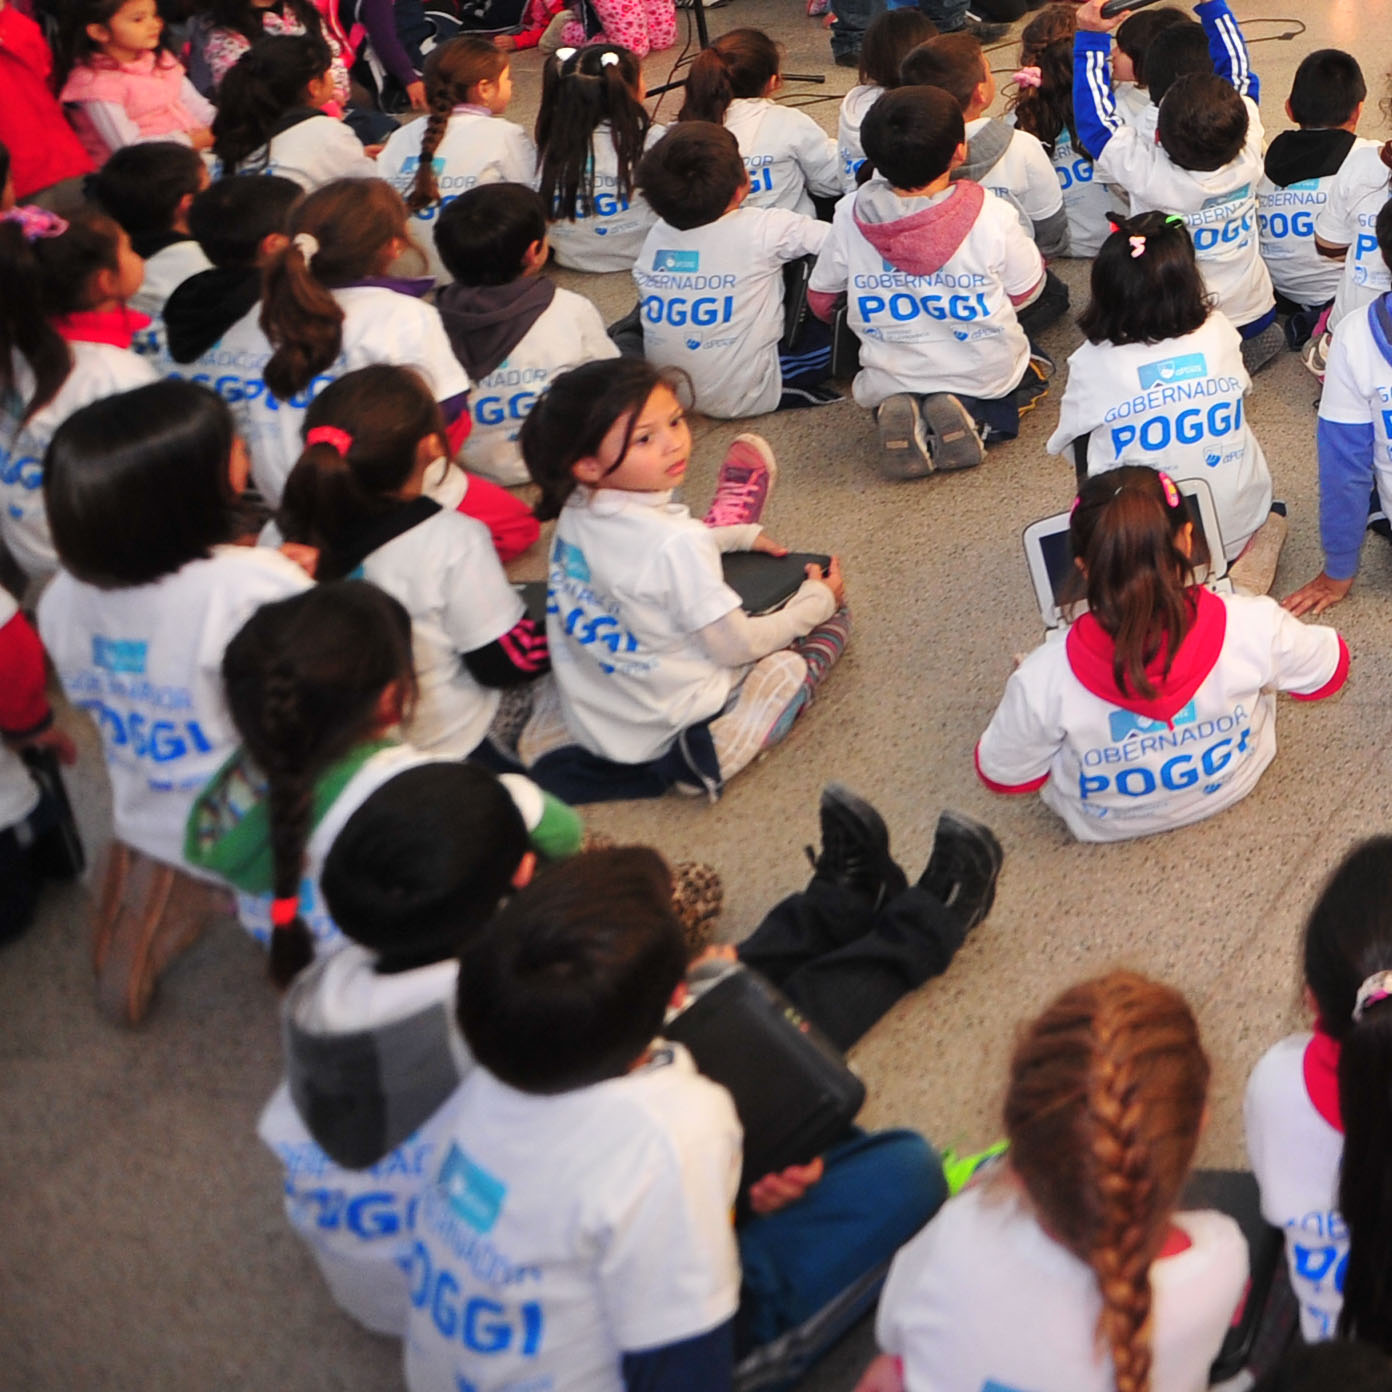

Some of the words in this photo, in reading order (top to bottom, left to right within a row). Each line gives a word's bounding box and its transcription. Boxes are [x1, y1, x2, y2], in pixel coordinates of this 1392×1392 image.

[641, 295, 734, 327] OGGI
[857, 291, 990, 323] POGGI
[1104, 376, 1242, 423] GOBERNADOR
[1110, 397, 1242, 461] POGGI
[1084, 704, 1248, 767] OBERNADOR
